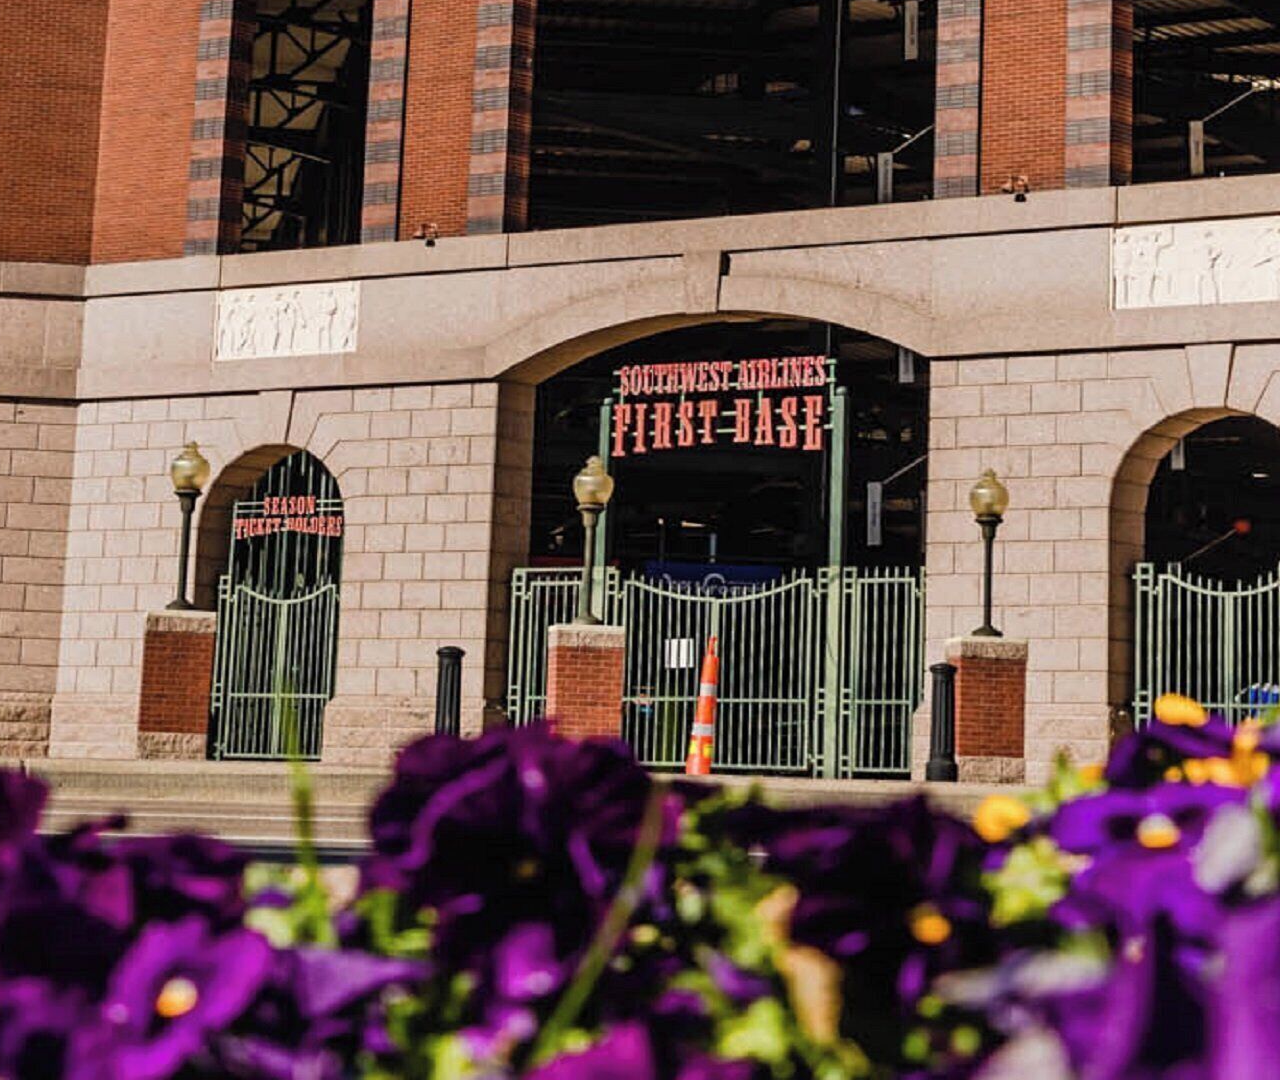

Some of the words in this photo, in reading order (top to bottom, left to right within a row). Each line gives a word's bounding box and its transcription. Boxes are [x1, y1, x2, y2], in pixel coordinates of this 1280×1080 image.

[619, 359, 734, 397] SOUTHWEST
[735, 355, 827, 391] AIRLINES
[611, 398, 719, 458] FIRST
[733, 394, 824, 452] BASE
[263, 496, 317, 515] SEASON
[233, 517, 282, 540] TICKET
[285, 515, 343, 537] HOLDERS
